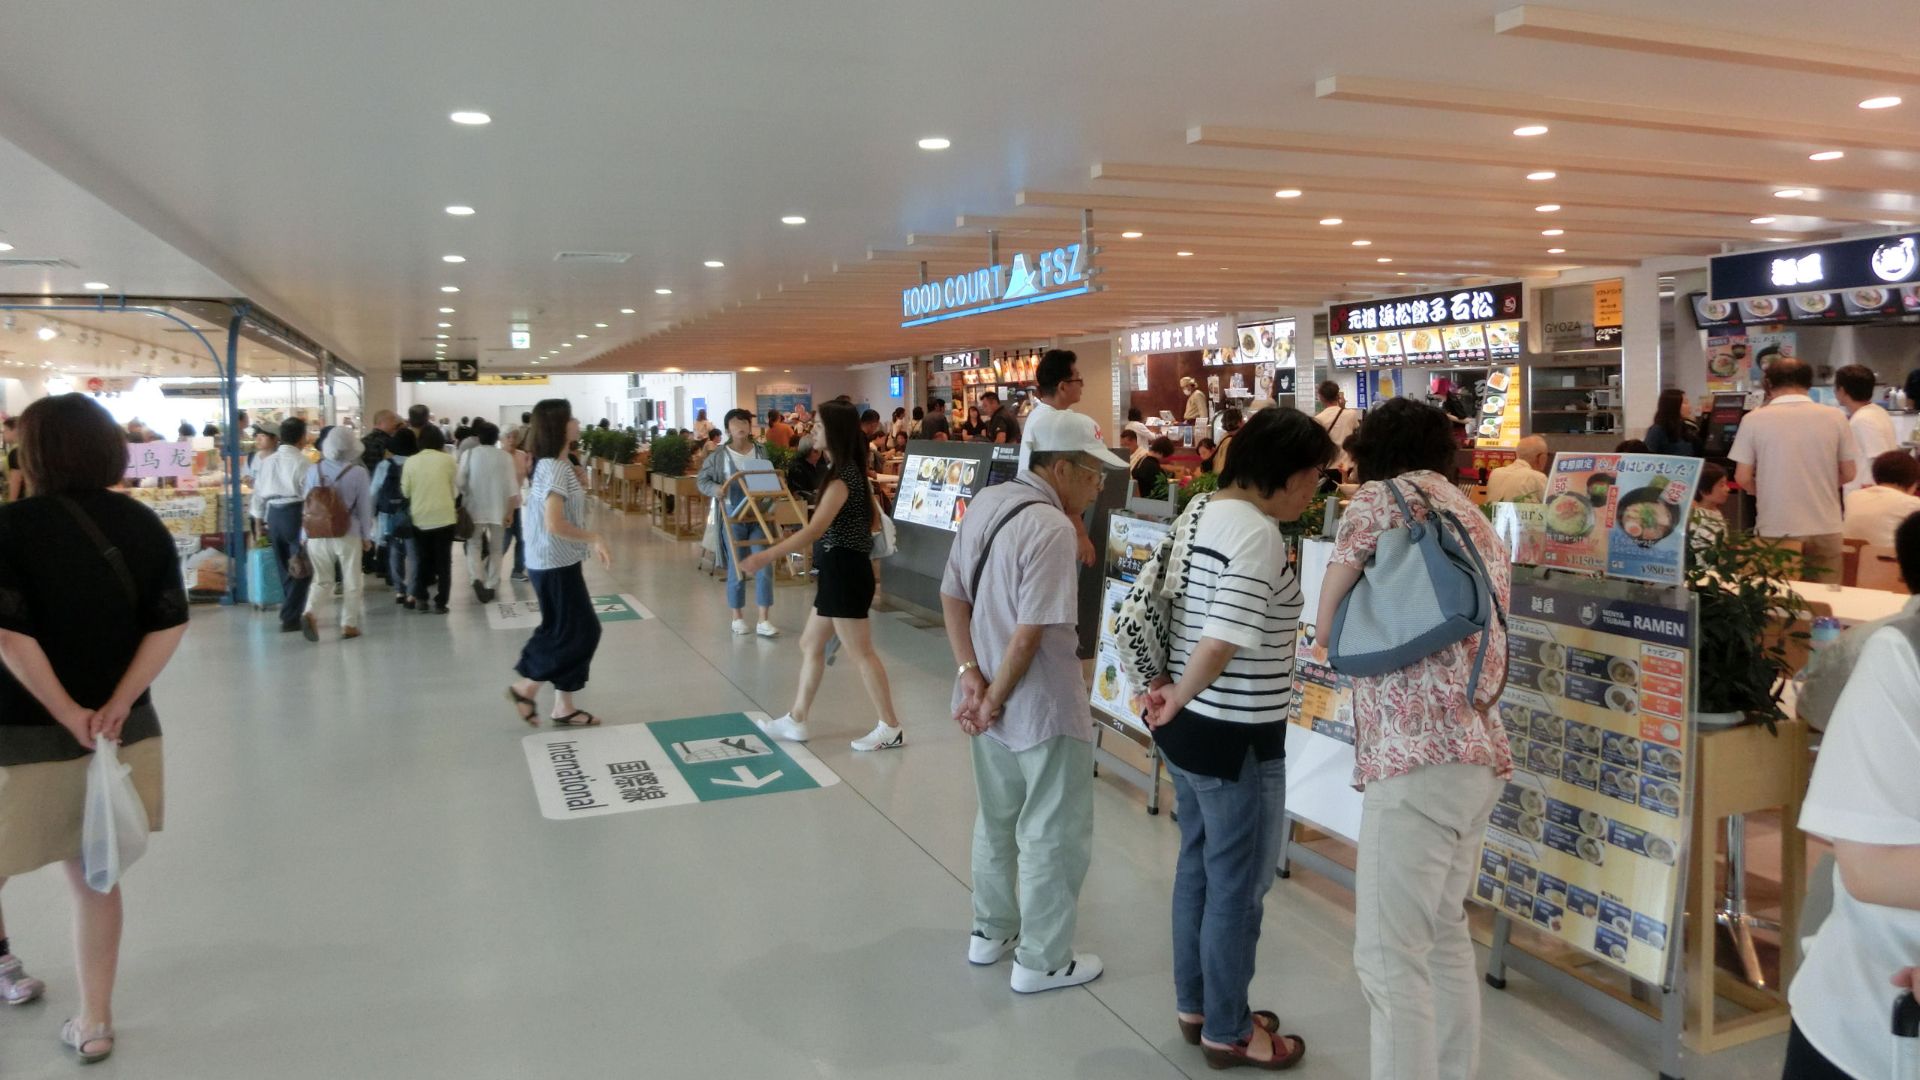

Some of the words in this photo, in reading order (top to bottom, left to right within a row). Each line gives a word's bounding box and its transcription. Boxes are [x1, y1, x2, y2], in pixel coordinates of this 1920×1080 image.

[903, 282, 941, 317] FOOD
[944, 264, 1002, 309] COURT
[1039, 243, 1082, 288] FSZ
[1451, 291, 1494, 320] 石松
[1545, 321, 1581, 333] GYOZA
[1558, 459, 1594, 472] 季節限定
[1633, 615, 1685, 637] RAMEN
[547, 740, 609, 811] International
[606, 760, 669, 804] 国際線
